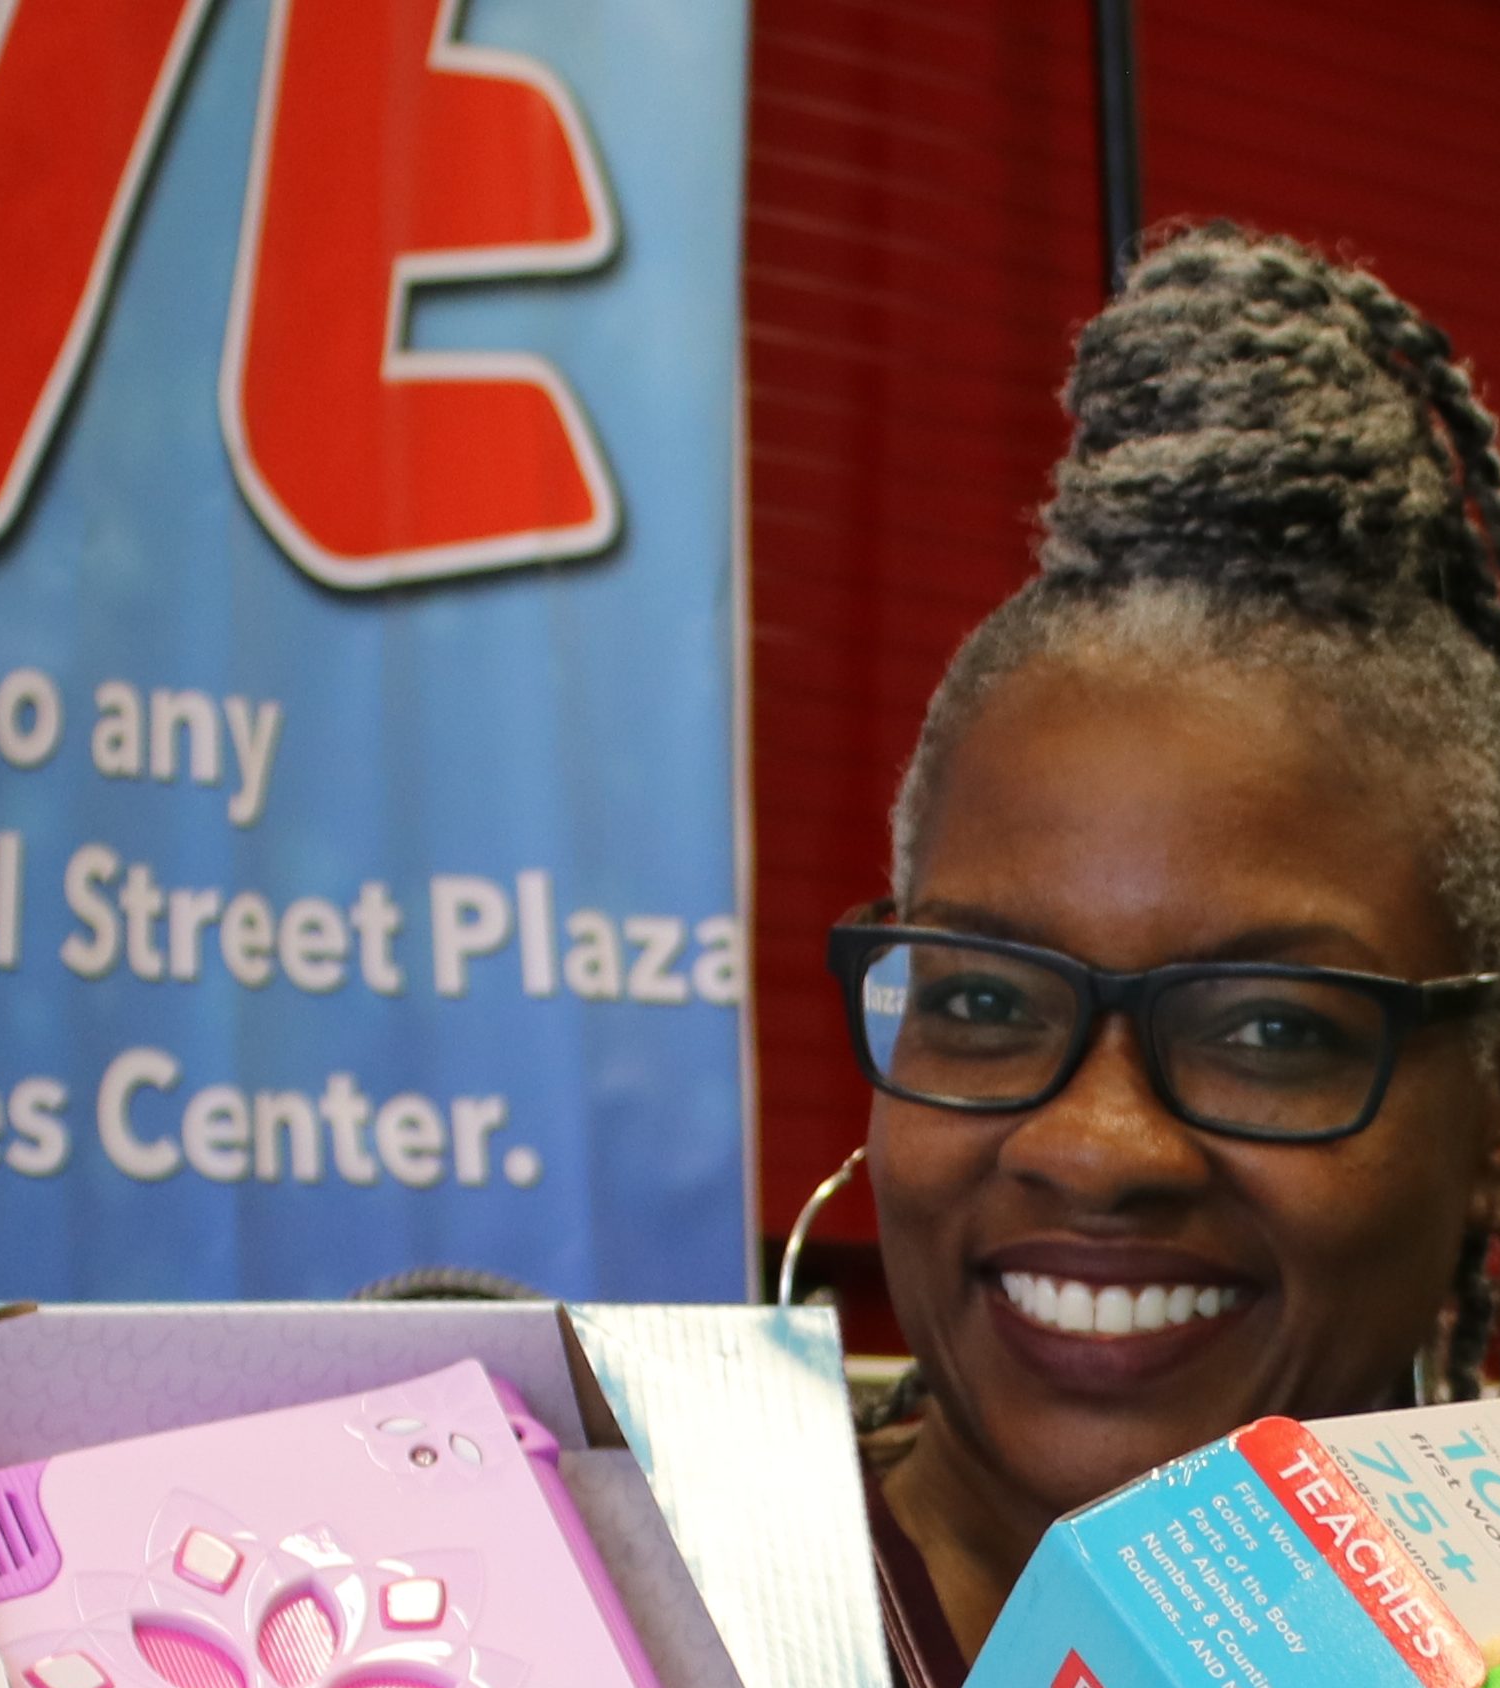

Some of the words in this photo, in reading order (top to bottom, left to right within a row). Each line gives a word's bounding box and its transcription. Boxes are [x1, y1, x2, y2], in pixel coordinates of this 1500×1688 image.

[93, 679, 281, 827] any
[61, 844, 406, 996] Street
[429, 869, 746, 1005] Plaza
[96, 1045, 541, 1189] Center.
[1211, 1494, 1259, 1552] Colors
[1233, 1480, 1271, 1523] First
[1267, 1521, 1315, 1581] Words
[1326, 1443, 1381, 1512] songs,
[1384, 1516, 1448, 1593] sounds
[1348, 1440, 1477, 1584] 75+
[1410, 1432, 1461, 1491] first
[1141, 1531, 1206, 1613] Numbers
[1202, 1612, 1220, 1629] &
[1166, 1519, 1195, 1554] The
[1191, 1556, 1260, 1636] Alphabet
[1188, 1507, 1227, 1553] Parts
[1225, 1553, 1248, 1575] of
[1241, 1574, 1270, 1606] the
[1265, 1605, 1307, 1655] Body
[1276, 1449, 1452, 1663] TEACHES
[1188, 1638, 1227, 1680] AND
